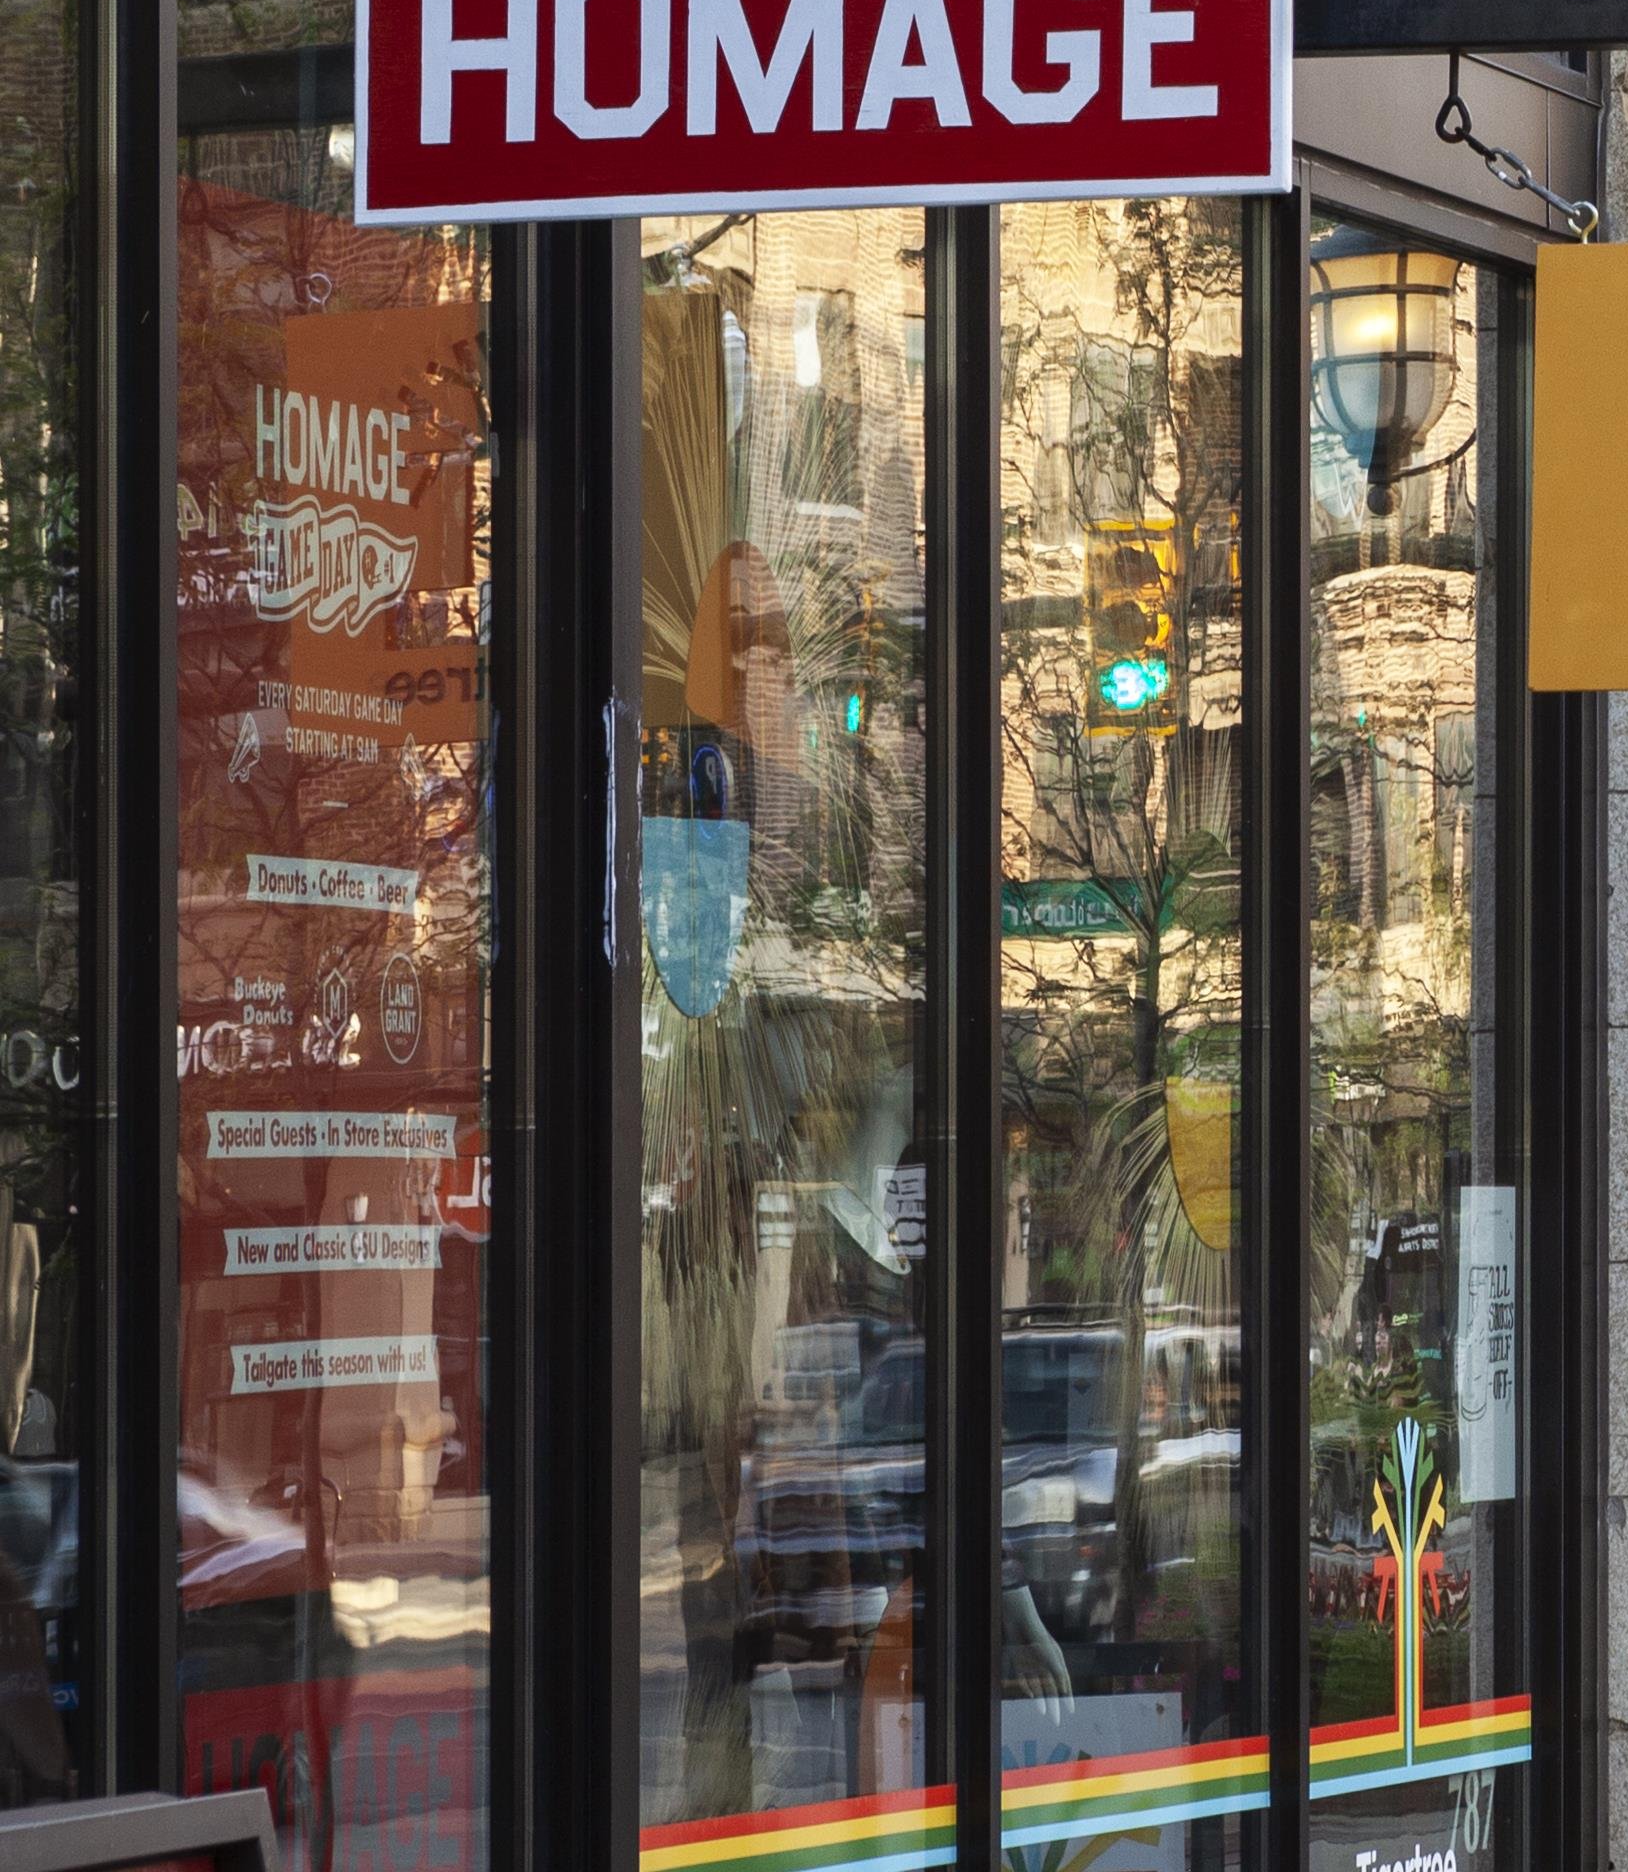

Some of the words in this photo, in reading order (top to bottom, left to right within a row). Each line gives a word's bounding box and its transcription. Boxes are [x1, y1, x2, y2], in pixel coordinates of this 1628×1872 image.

[256, 383, 411, 506] HOMAGE
[264, 520, 315, 595] GAME
[321, 531, 356, 600] DAY
[258, 680, 292, 710] EVERY
[295, 685, 351, 718] SATURDAY
[354, 694, 382, 723] GAME
[383, 699, 404, 727] DAY
[285, 726, 339, 759] STARTING
[341, 733, 354, 760] AT
[356, 736, 379, 764] 9AM
[258, 863, 308, 896] Donuts
[319, 868, 365, 900] Coffee
[377, 874, 409, 905] Beer
[234, 975, 286, 1008] Buckeye
[387, 982, 415, 1008] LAND
[243, 1003, 294, 1026] Donuts
[385, 1009, 417, 1035] GRANT
[217, 1117, 266, 1154] Special
[269, 1118, 317, 1149] Guests
[327, 1118, 340, 1147] In
[344, 1118, 380, 1148] Store
[237, 1235, 269, 1265] New
[274, 1233, 299, 1263] and
[303, 1231, 347, 1262] Classic
[381, 1232, 430, 1265] Designs
[243, 1351, 297, 1387] Tailgate
[302, 1348, 324, 1378] this
[328, 1353, 373, 1376] season
[377, 1346, 405, 1373] with
[408, 1344, 426, 1372] us!
[1448, 1767, 1497, 1855] 787
